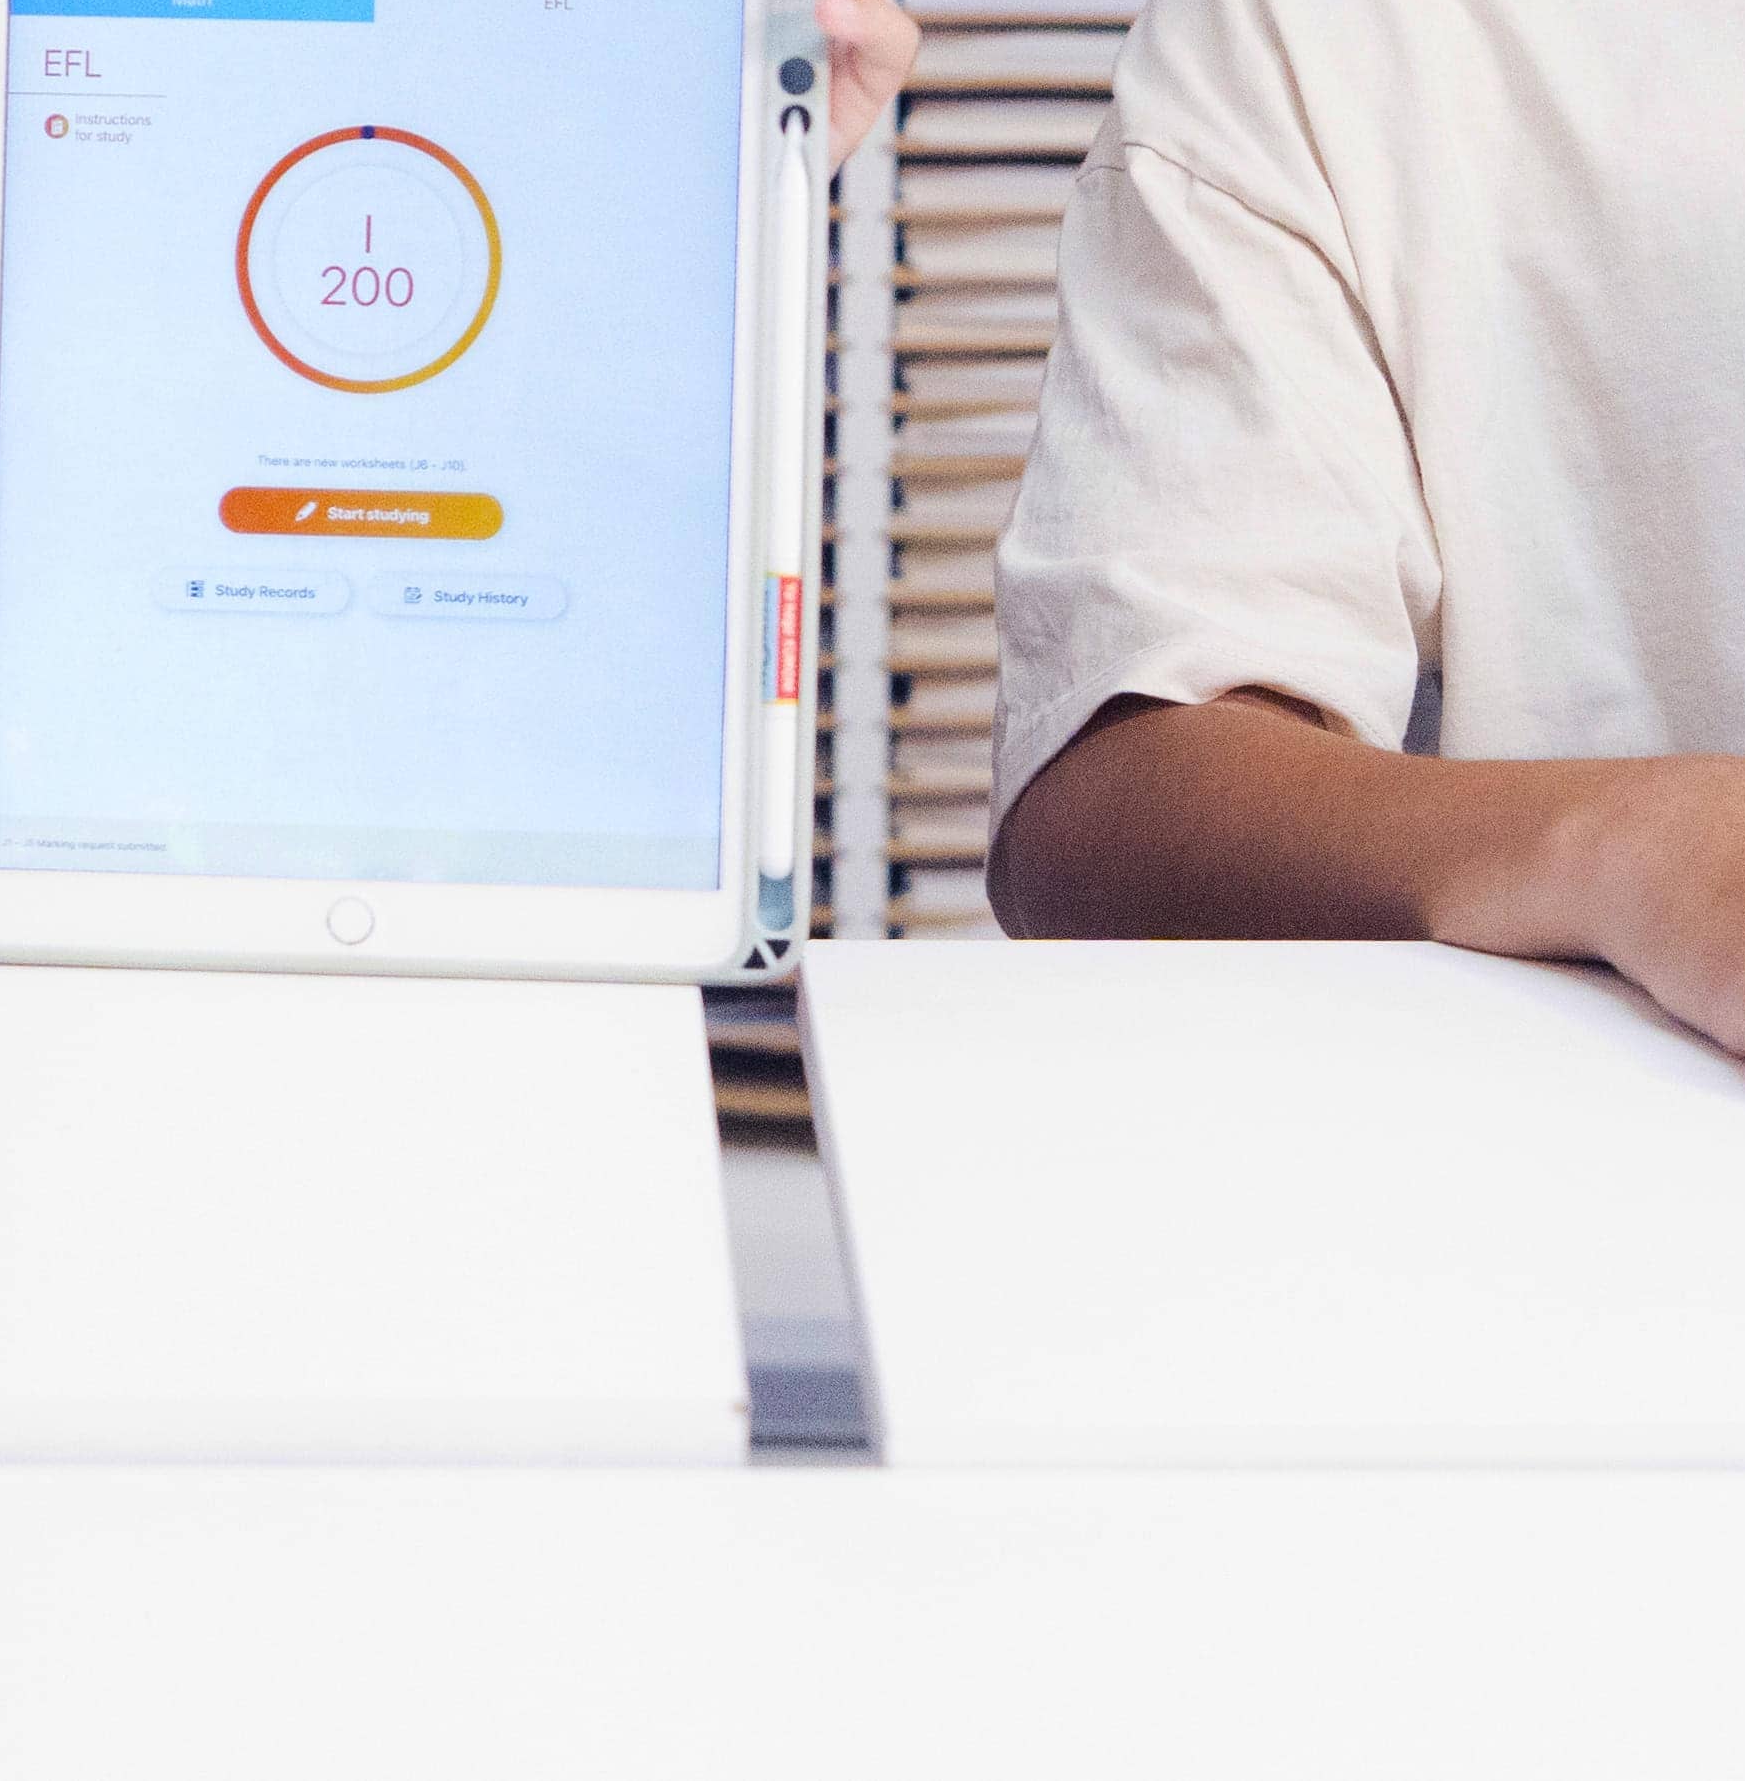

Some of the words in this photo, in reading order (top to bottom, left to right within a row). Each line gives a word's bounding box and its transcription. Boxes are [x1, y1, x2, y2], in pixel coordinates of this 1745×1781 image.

[44, 49, 102, 78] EFL
[75, 113, 152, 126] Instructions
[75, 130, 92, 142] for
[96, 130, 133, 145] study
[320, 265, 414, 308] 200
[258, 455, 289, 467] There
[293, 458, 311, 468] are
[314, 458, 337, 468] new
[341, 458, 406, 470] worksheets
[327, 506, 364, 521] Start
[367, 506, 430, 526] studying
[215, 583, 255, 601] Study
[259, 585, 316, 600] Records
[433, 589, 475, 606] Study
[478, 590, 529, 608] History
